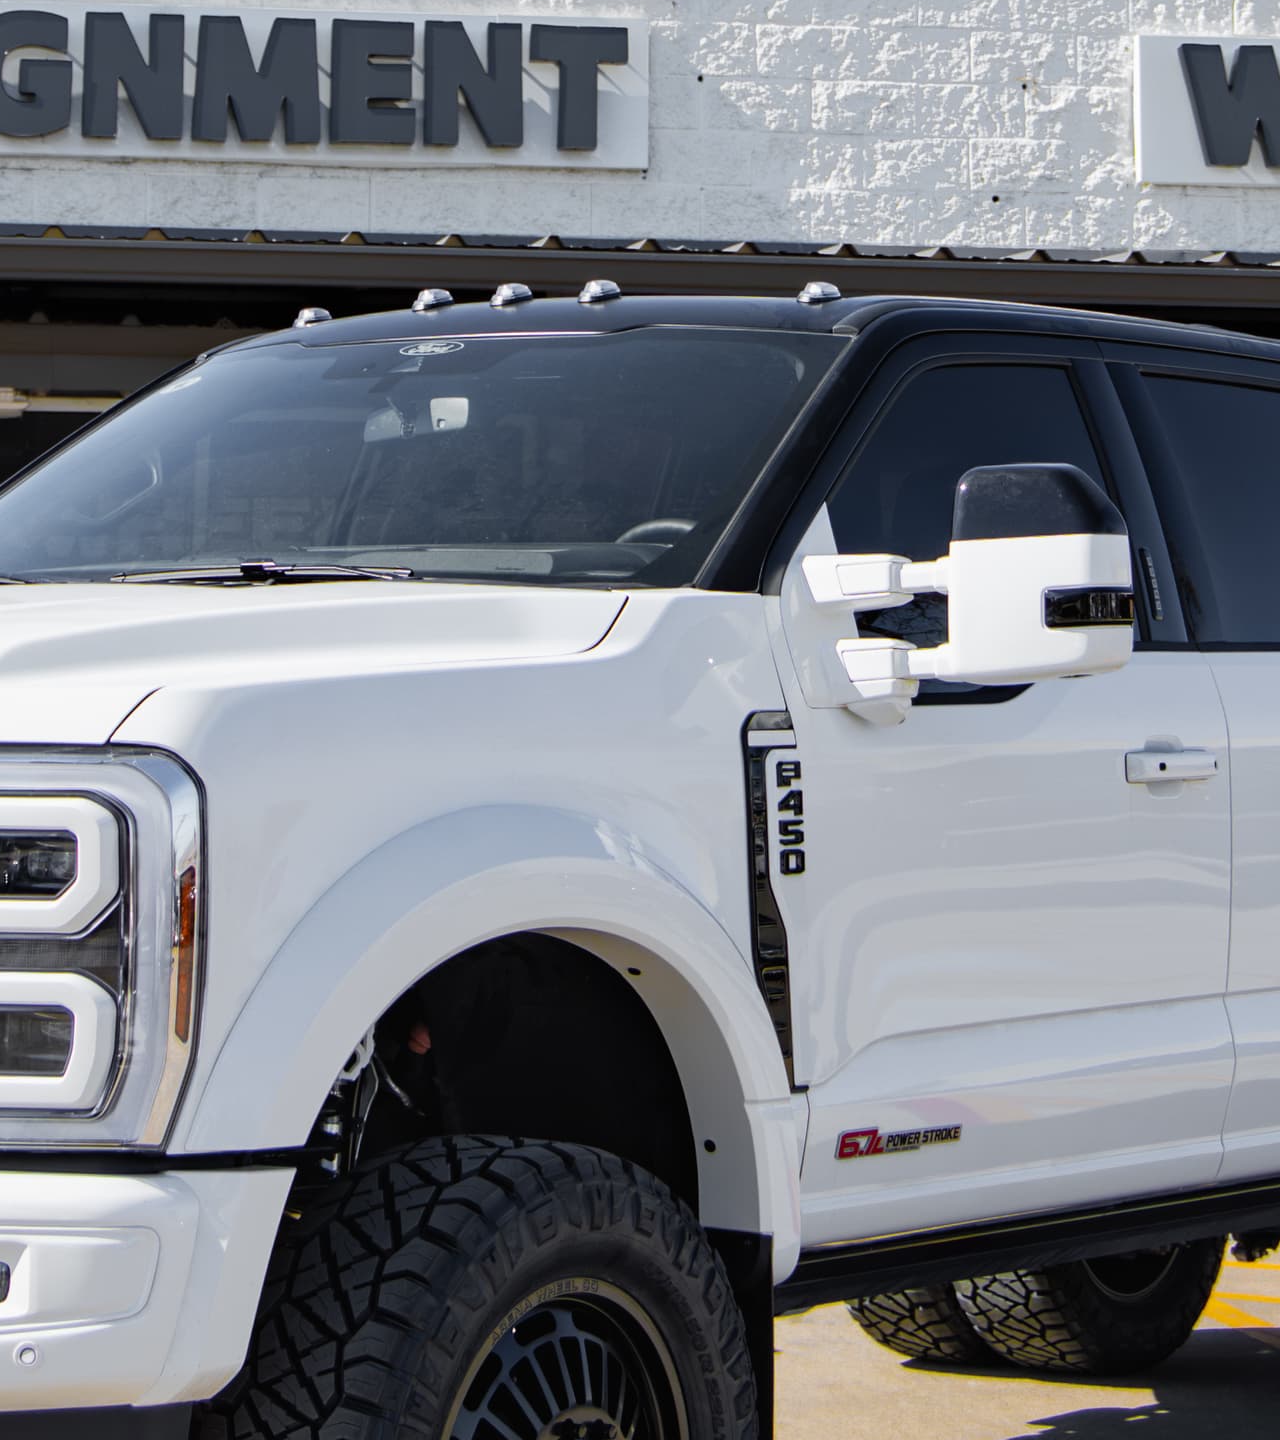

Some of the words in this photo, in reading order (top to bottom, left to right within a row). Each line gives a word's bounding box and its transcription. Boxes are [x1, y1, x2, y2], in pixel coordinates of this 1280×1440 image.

[837, 1128, 884, 1159] 6.7L
[886, 1132, 921, 1149] POWER
[922, 1125, 961, 1143] STROKE
